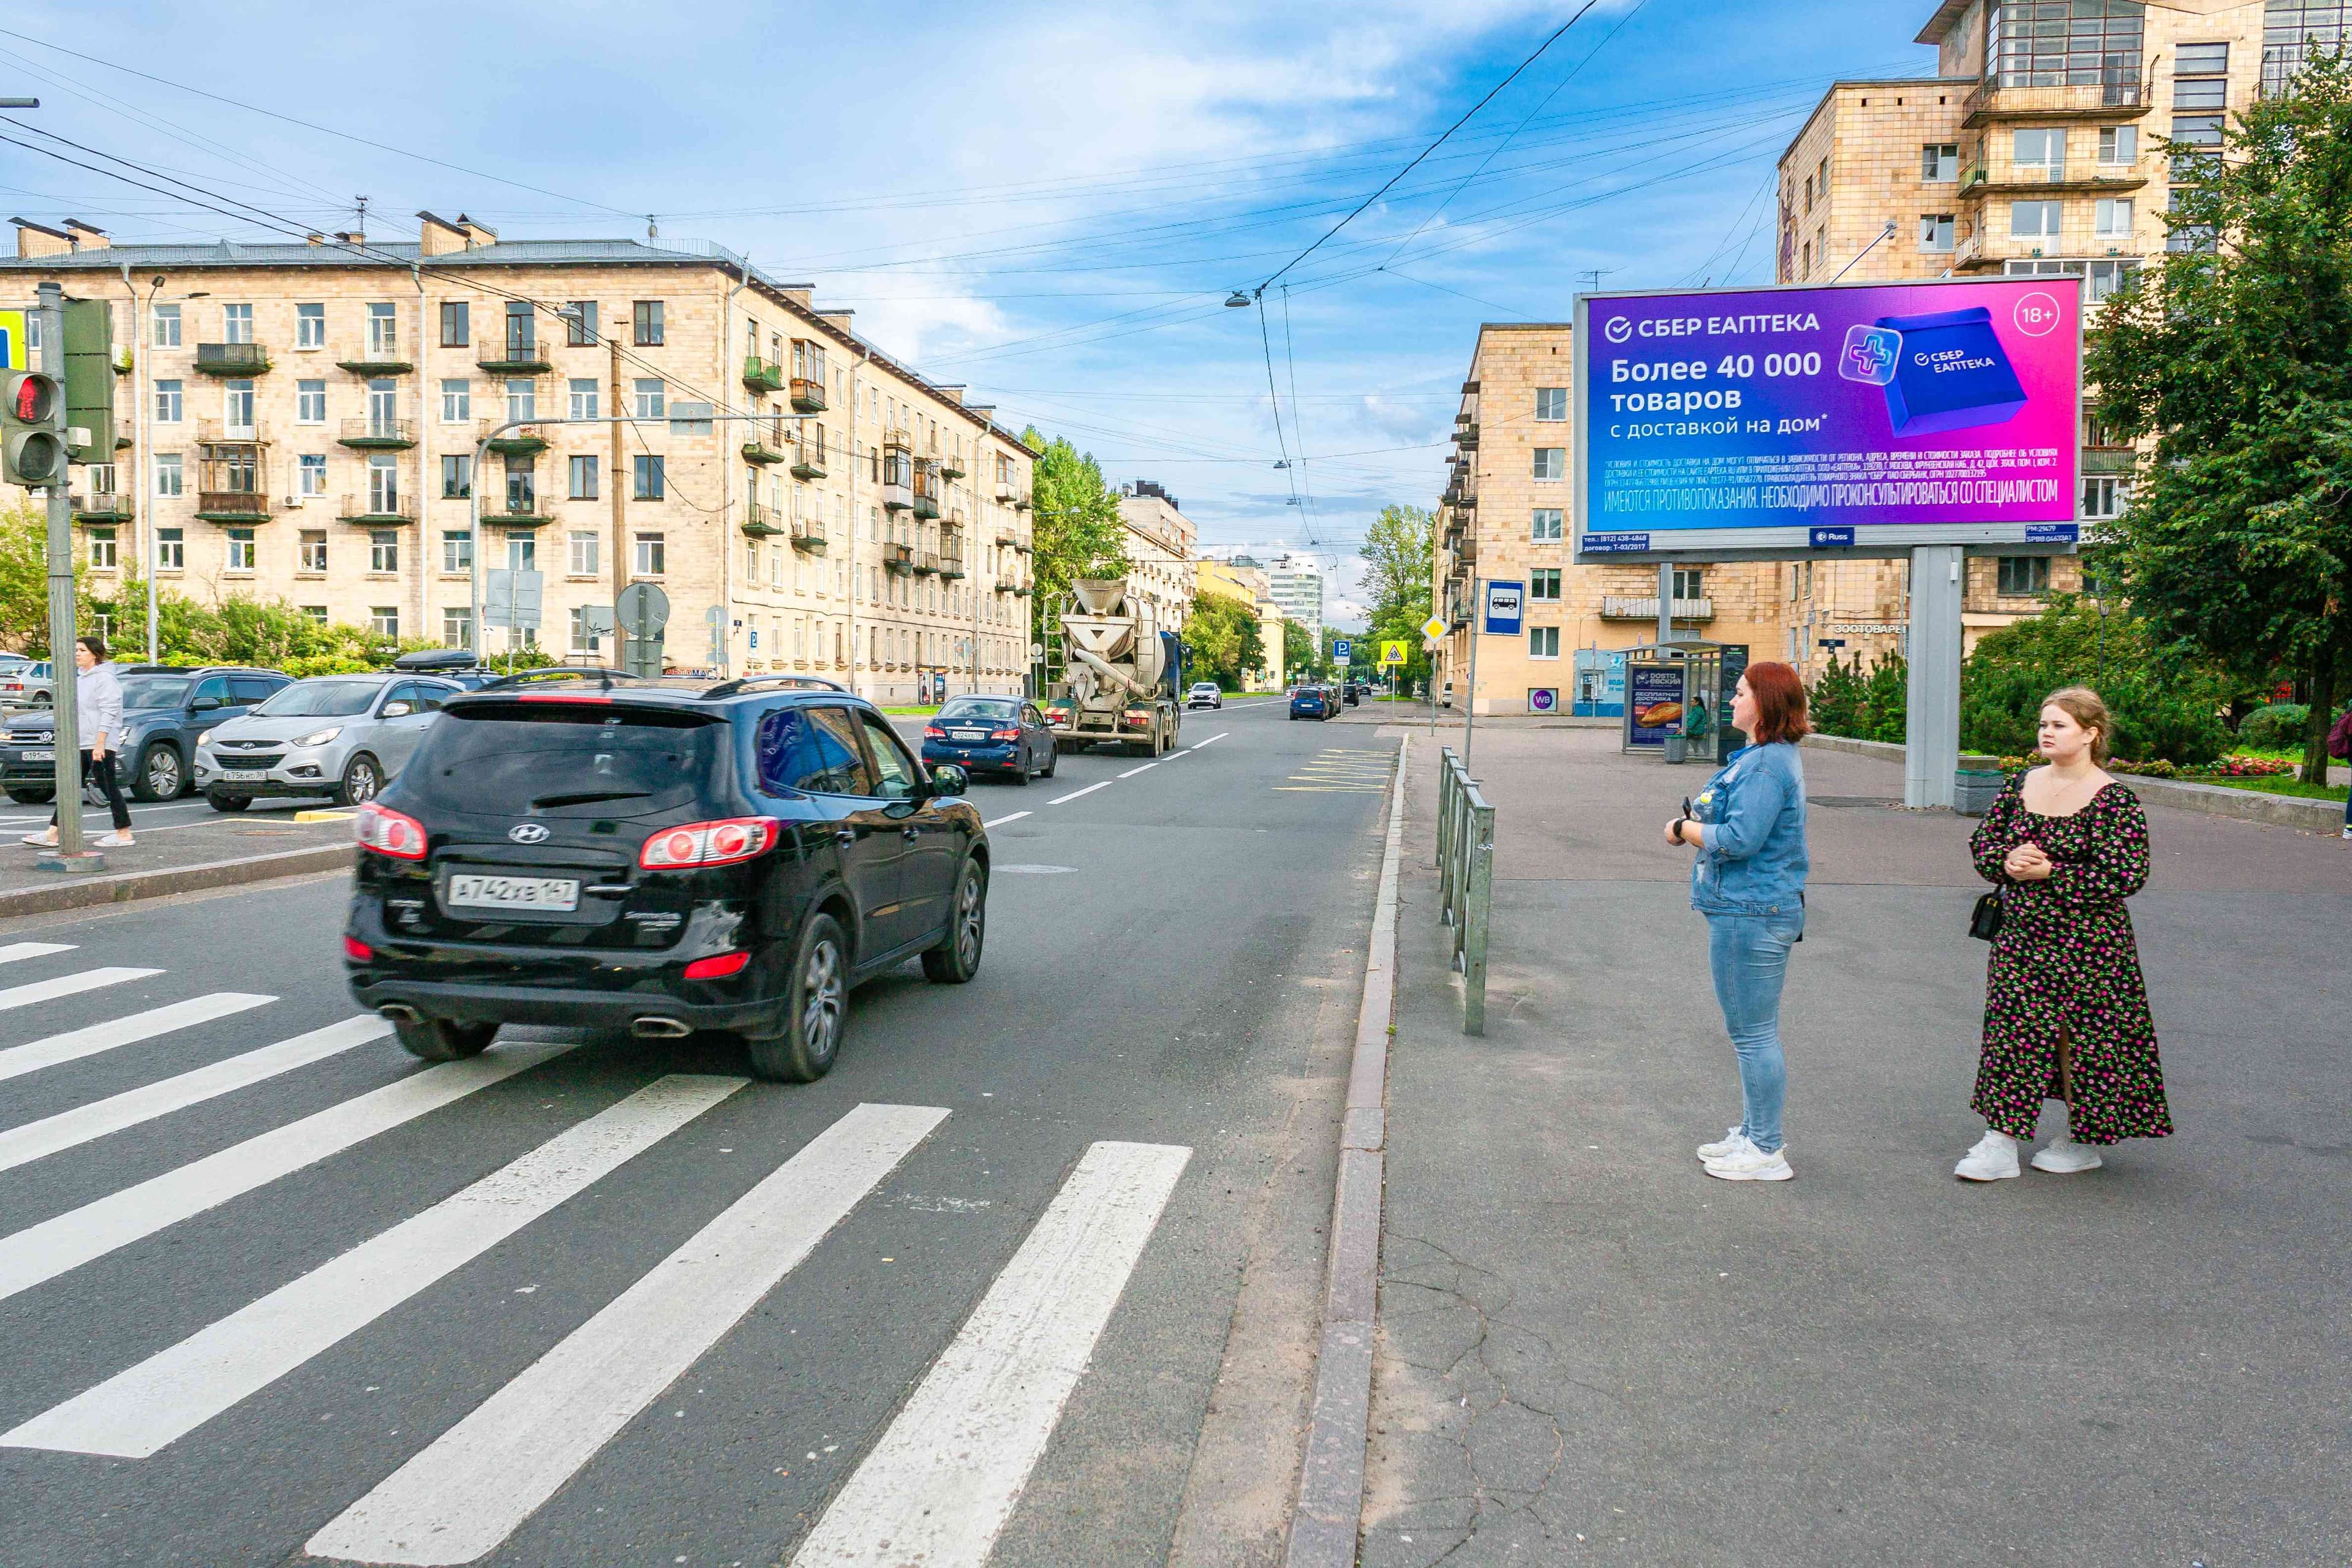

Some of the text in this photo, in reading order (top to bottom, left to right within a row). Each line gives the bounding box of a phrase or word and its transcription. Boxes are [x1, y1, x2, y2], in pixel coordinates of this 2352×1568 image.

[2022, 308, 2053, 323] 18+
[1638, 314, 1820, 337] СБЕР ЕАПТЕКА
[1930, 350, 1964, 362] СБЕР
[1934, 357, 1996, 374] ЕАПТЕКА
[1612, 352, 1822, 382] Более 40 000
[1610, 390, 1741, 415] товаров
[1610, 424, 1621, 438] с
[1627, 417, 1738, 439] доставкой
[1746, 420, 1771, 434] на
[1605, 480, 2058, 511] ИМЕЮТСЯ ПРОТИВОПОКАЗАНИЯ. НЕОБХОДИМО ПРОКОНСУЛЬТИРОВАТЬСЯ СО СПЕЦИАЛИСТОМ
[1834, 625, 1906, 634] ЗООТОВАРЫ
[1338, 643, 1348, 655] P
